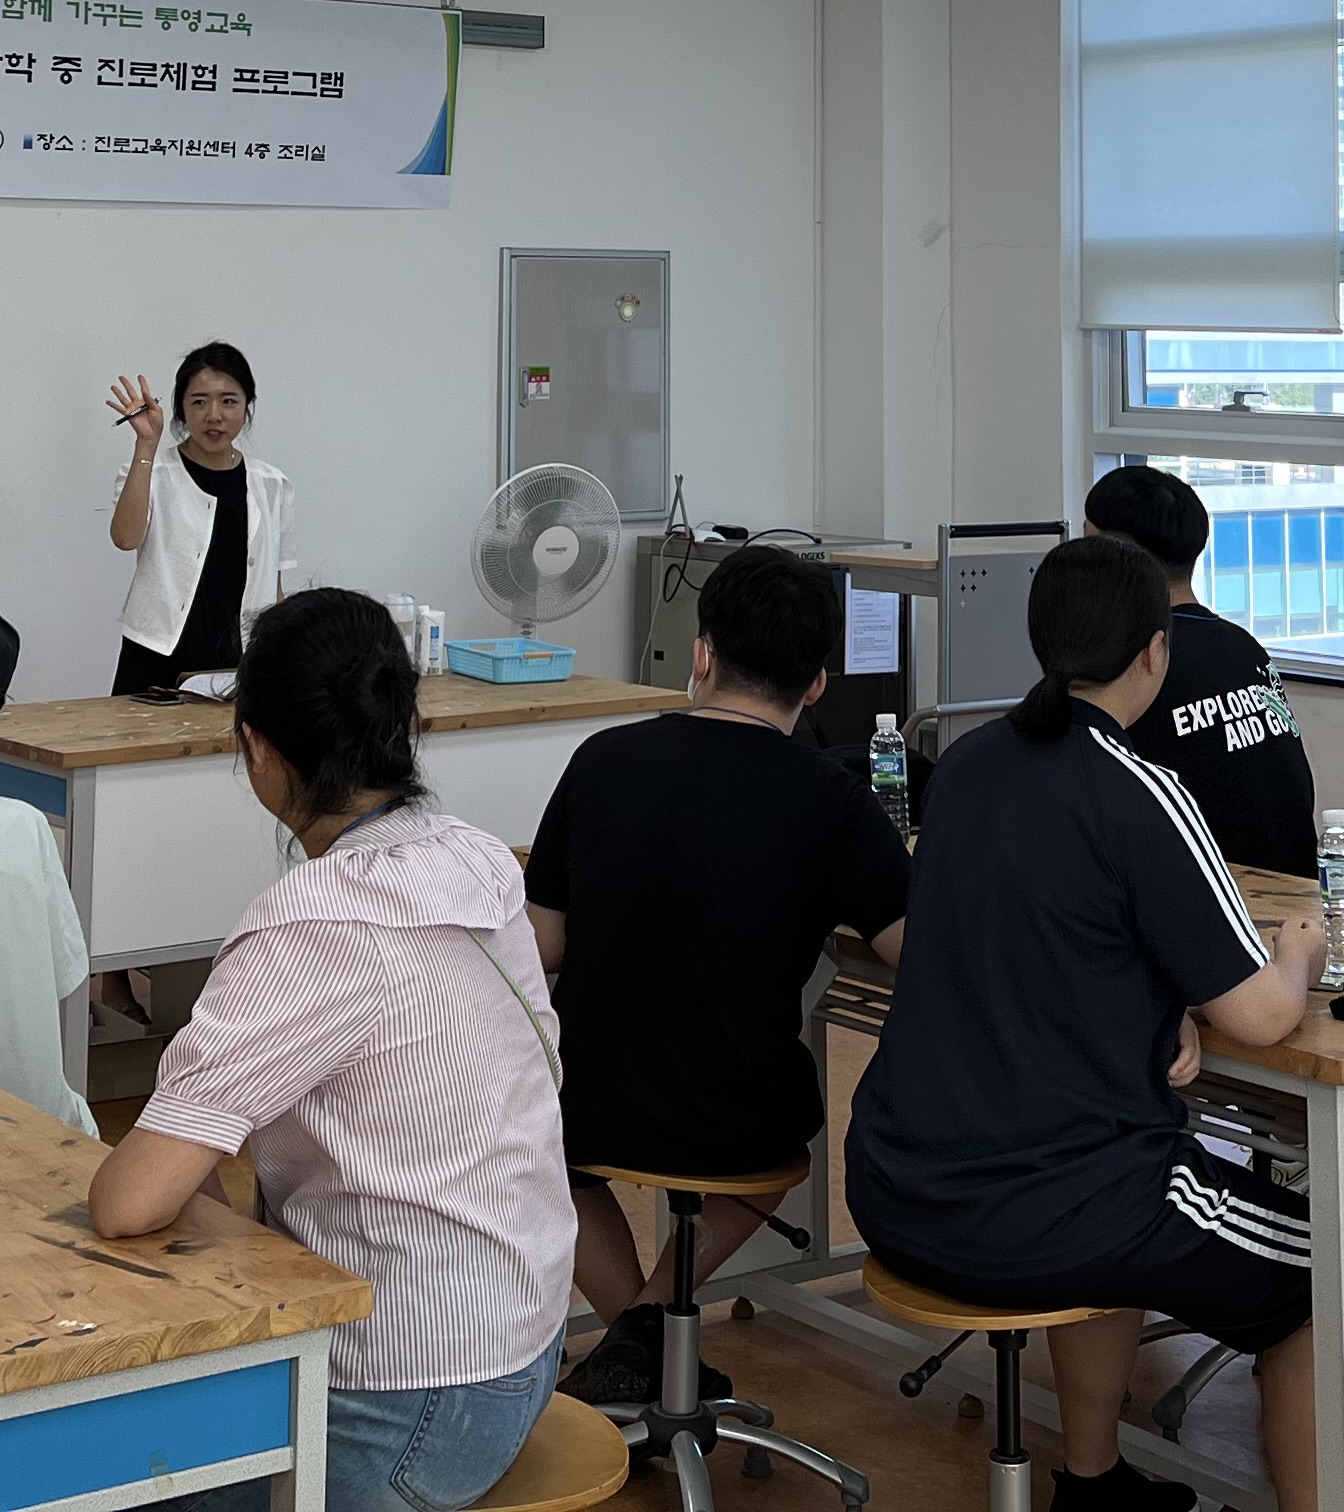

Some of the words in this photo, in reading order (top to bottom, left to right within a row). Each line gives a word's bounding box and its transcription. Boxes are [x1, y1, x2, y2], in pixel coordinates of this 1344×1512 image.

[67, 1, 143, 28] 가꾸는
[155, 8, 253, 36] 통영교육
[51, 55, 83, 85] 중
[97, 58, 217, 92] 진로체험
[232, 67, 345, 99] 프로그램
[36, 133, 75, 152] 장소
[94, 135, 237, 159] 진로교육지원센터
[244, 142, 271, 160] 4층
[277, 143, 326, 162] 조리실
[1225, 716, 1265, 752] AND
